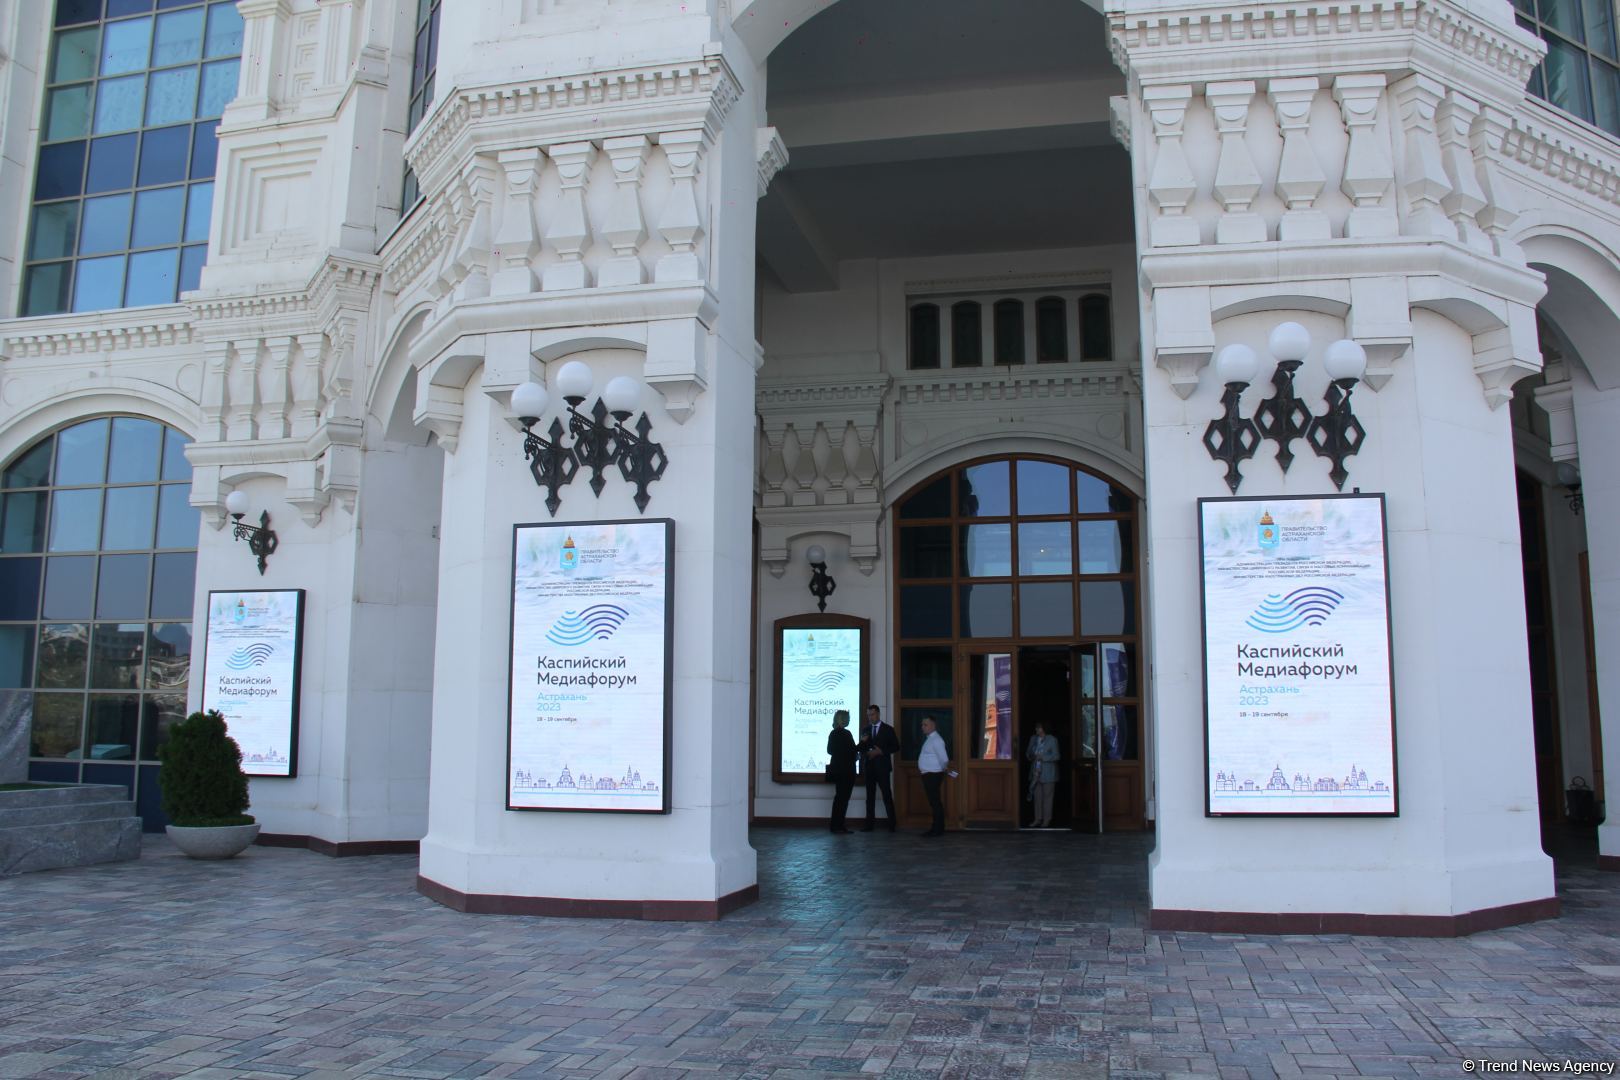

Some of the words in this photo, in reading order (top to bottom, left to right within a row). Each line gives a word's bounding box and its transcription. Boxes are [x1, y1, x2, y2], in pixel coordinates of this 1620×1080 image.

[1237, 643, 1344, 658] Каспийский
[537, 655, 626, 669] Каспийский
[1237, 661, 1358, 679] Медиафорум
[219, 675, 272, 685] Каспийский
[537, 672, 637, 688] Медиафорум
[219, 686, 278, 697] Медиафорум
[1239, 684, 1300, 695] Астрахань
[537, 692, 588, 702] Астрахань
[794, 698, 845, 706] Каспийский
[1239, 696, 1269, 706] 2023
[537, 702, 561, 711] 2023
